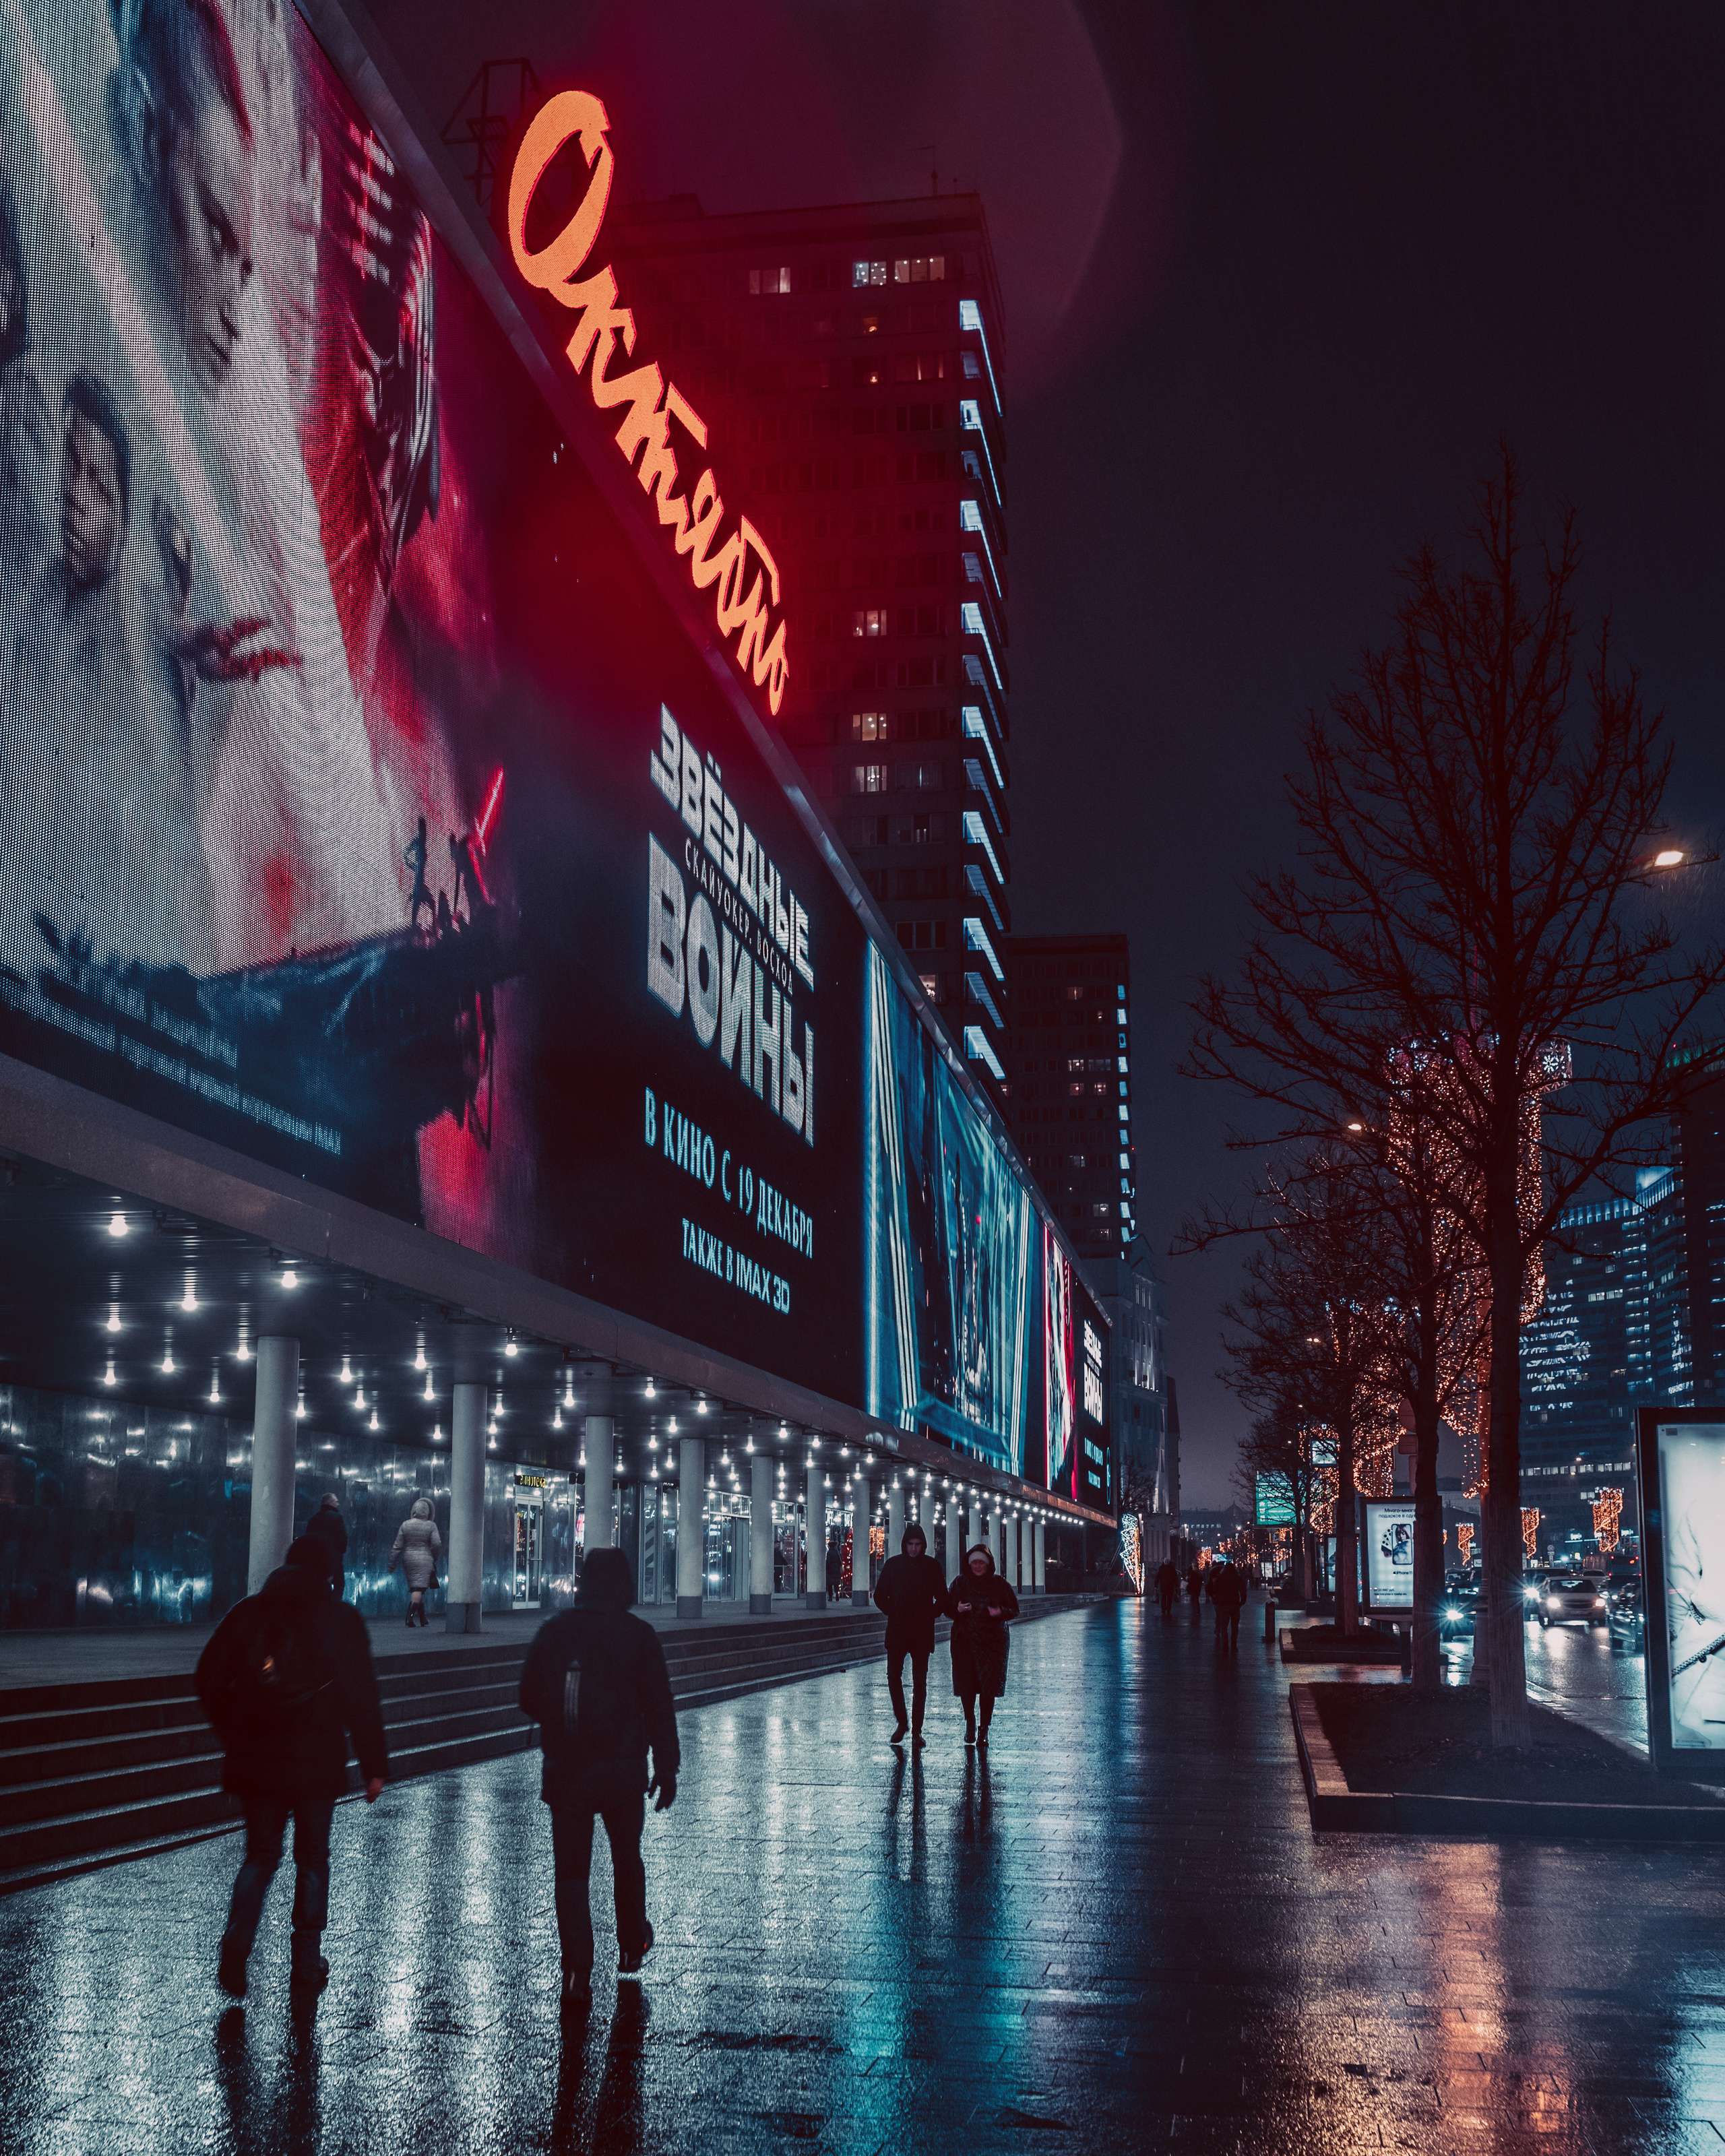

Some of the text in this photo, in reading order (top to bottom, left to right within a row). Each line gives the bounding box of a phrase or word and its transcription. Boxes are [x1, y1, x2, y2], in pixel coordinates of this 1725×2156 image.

[650, 701, 814, 993] ЗВЁЗДНЫЕ
[756, 928, 793, 997] ВОСХОД
[645, 1086, 813, 1259] В КИНО С 19 ДЕКАБРЯ
[682, 1217, 790, 1314] ТАКЖЕ В IMAX 3D
